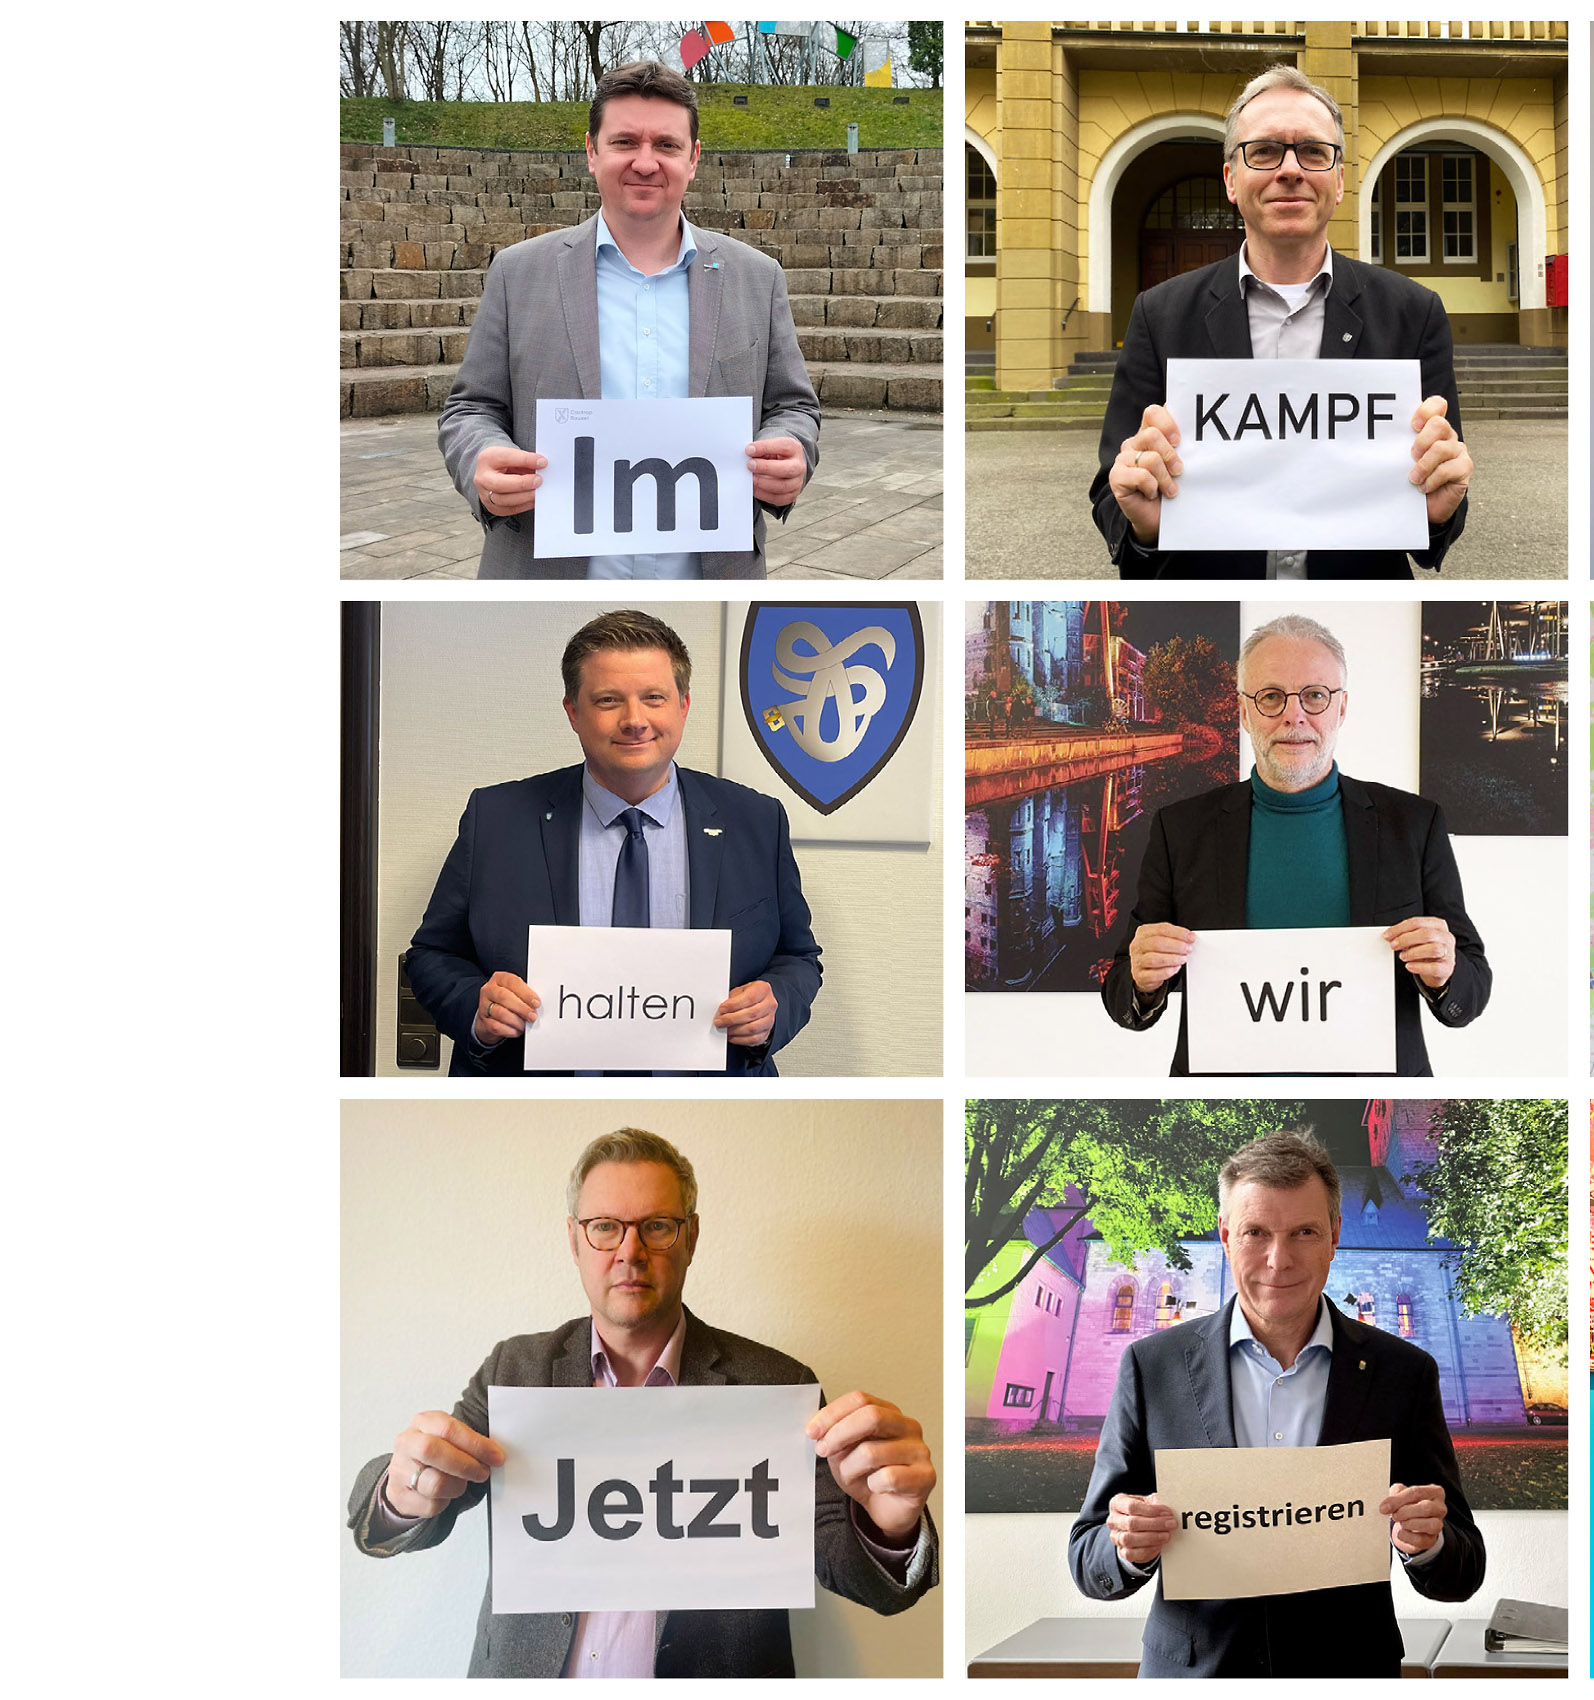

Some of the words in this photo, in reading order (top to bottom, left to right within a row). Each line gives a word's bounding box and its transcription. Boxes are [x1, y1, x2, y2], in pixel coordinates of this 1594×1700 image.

[1195, 392, 1397, 442] KAMPF
[573, 436, 719, 535] Im
[558, 984, 695, 1020] halten
[1239, 966, 1342, 1023] wir
[521, 1458, 780, 1542] Jetzt
[1181, 1499, 1365, 1535] registrieren
